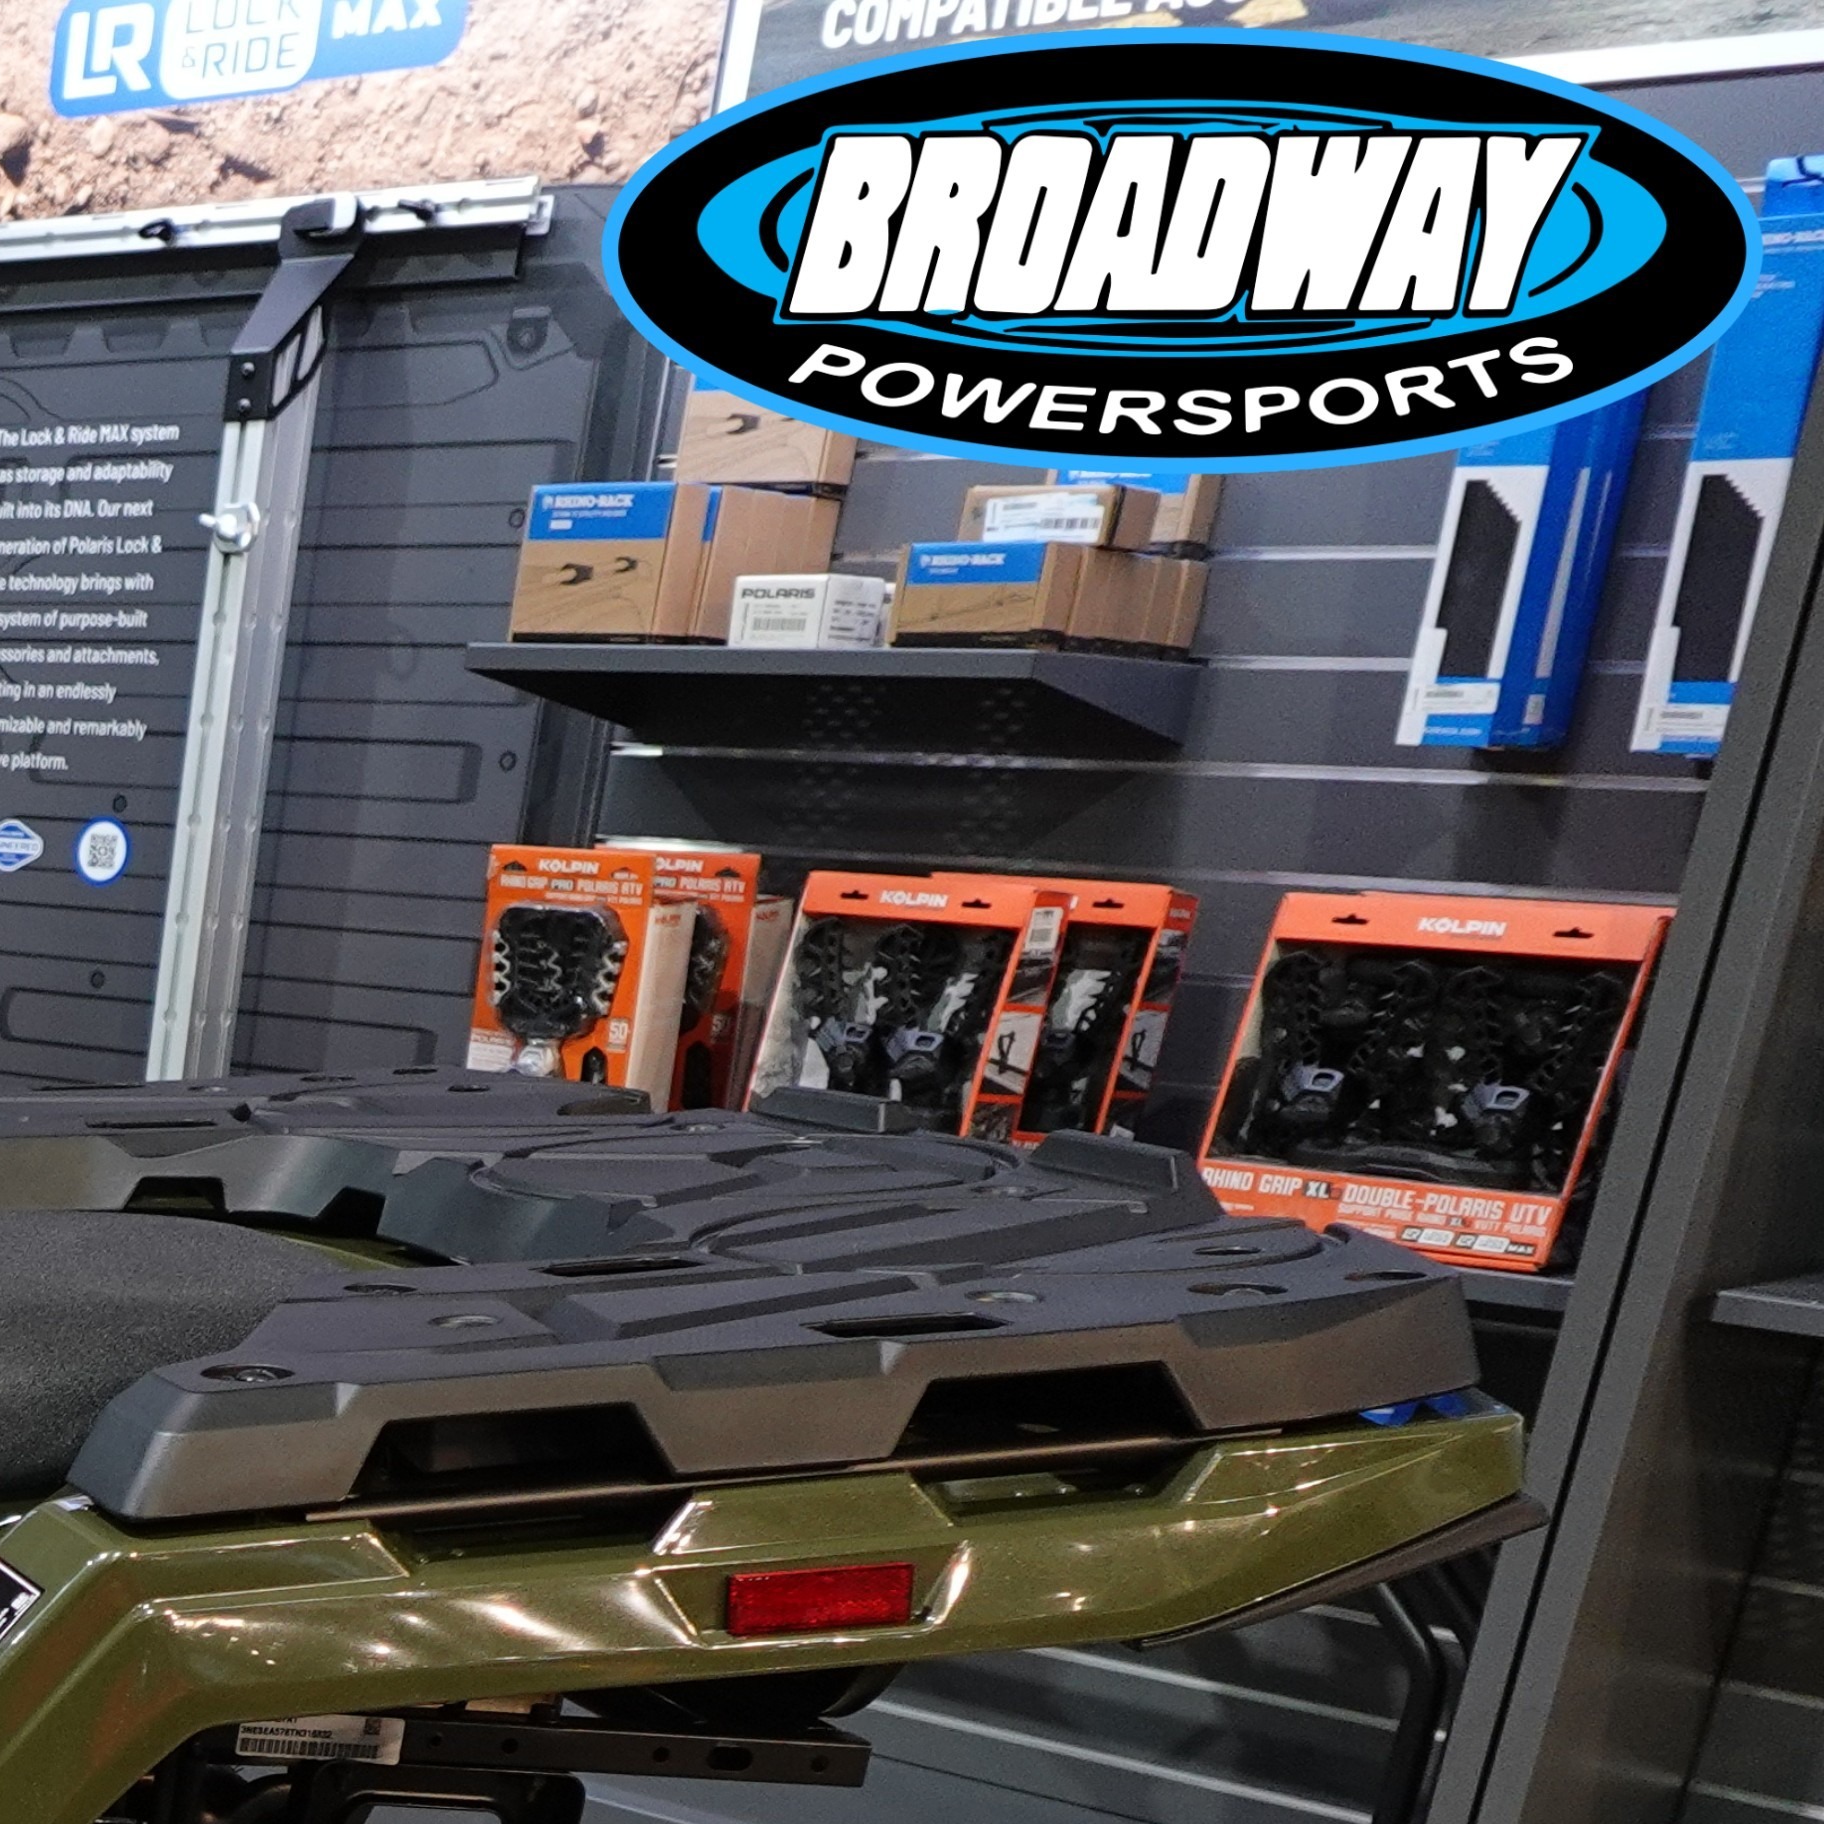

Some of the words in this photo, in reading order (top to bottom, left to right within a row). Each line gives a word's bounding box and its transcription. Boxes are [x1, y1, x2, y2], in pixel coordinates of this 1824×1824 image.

[331, 0, 444, 39] MAX
[62, 3, 156, 100] LR
[201, 33, 300, 79] RIDE
[21, 427, 52, 446] Lock
[54, 426, 65, 444] &
[67, 426, 97, 443] Ride
[99, 424, 130, 443] MAX
[130, 425, 179, 446] system
[15, 463, 64, 486] storage
[66, 463, 91, 482] and
[93, 460, 173, 484] adaptability
[17, 502, 42, 519] into
[44, 501, 61, 518] its
[63, 500, 94, 518] DNA.
[97, 500, 121, 517] Our
[123, 501, 154, 517] next
[52, 537, 67, 554] of
[69, 536, 114, 553] Polaris
[116, 535, 149, 553] Lock
[151, 535, 162, 552] &
[8, 572, 78, 594] technology
[80, 573, 122, 594] brings
[124, 573, 154, 590] with
[741, 588, 816, 599] POLARIS
[44, 609, 58, 627] of
[59, 609, 148, 631] purpose-built
[46, 646, 72, 663] and
[73, 647, 160, 665] attachments,
[23, 681, 36, 698] in
[38, 685, 54, 698] an
[56, 682, 116, 704] endlessly
[46, 719, 72, 734] and
[73, 719, 147, 741] remarkably
[11, 752, 69, 771] platform.
[538, 858, 599, 875] KOLPIN
[655, 857, 704, 872] OLPIN
[880, 890, 949, 908] KOLPIN
[1418, 916, 1507, 938] KOLPIN
[1203, 1167, 1253, 1191] RHINO
[1258, 1174, 1302, 1196] GRIP
[1305, 1182, 1329, 1198] XL
[1342, 1183, 1506, 1220] DOUBLE-POLARIS
[1510, 1204, 1552, 1226] UTV
